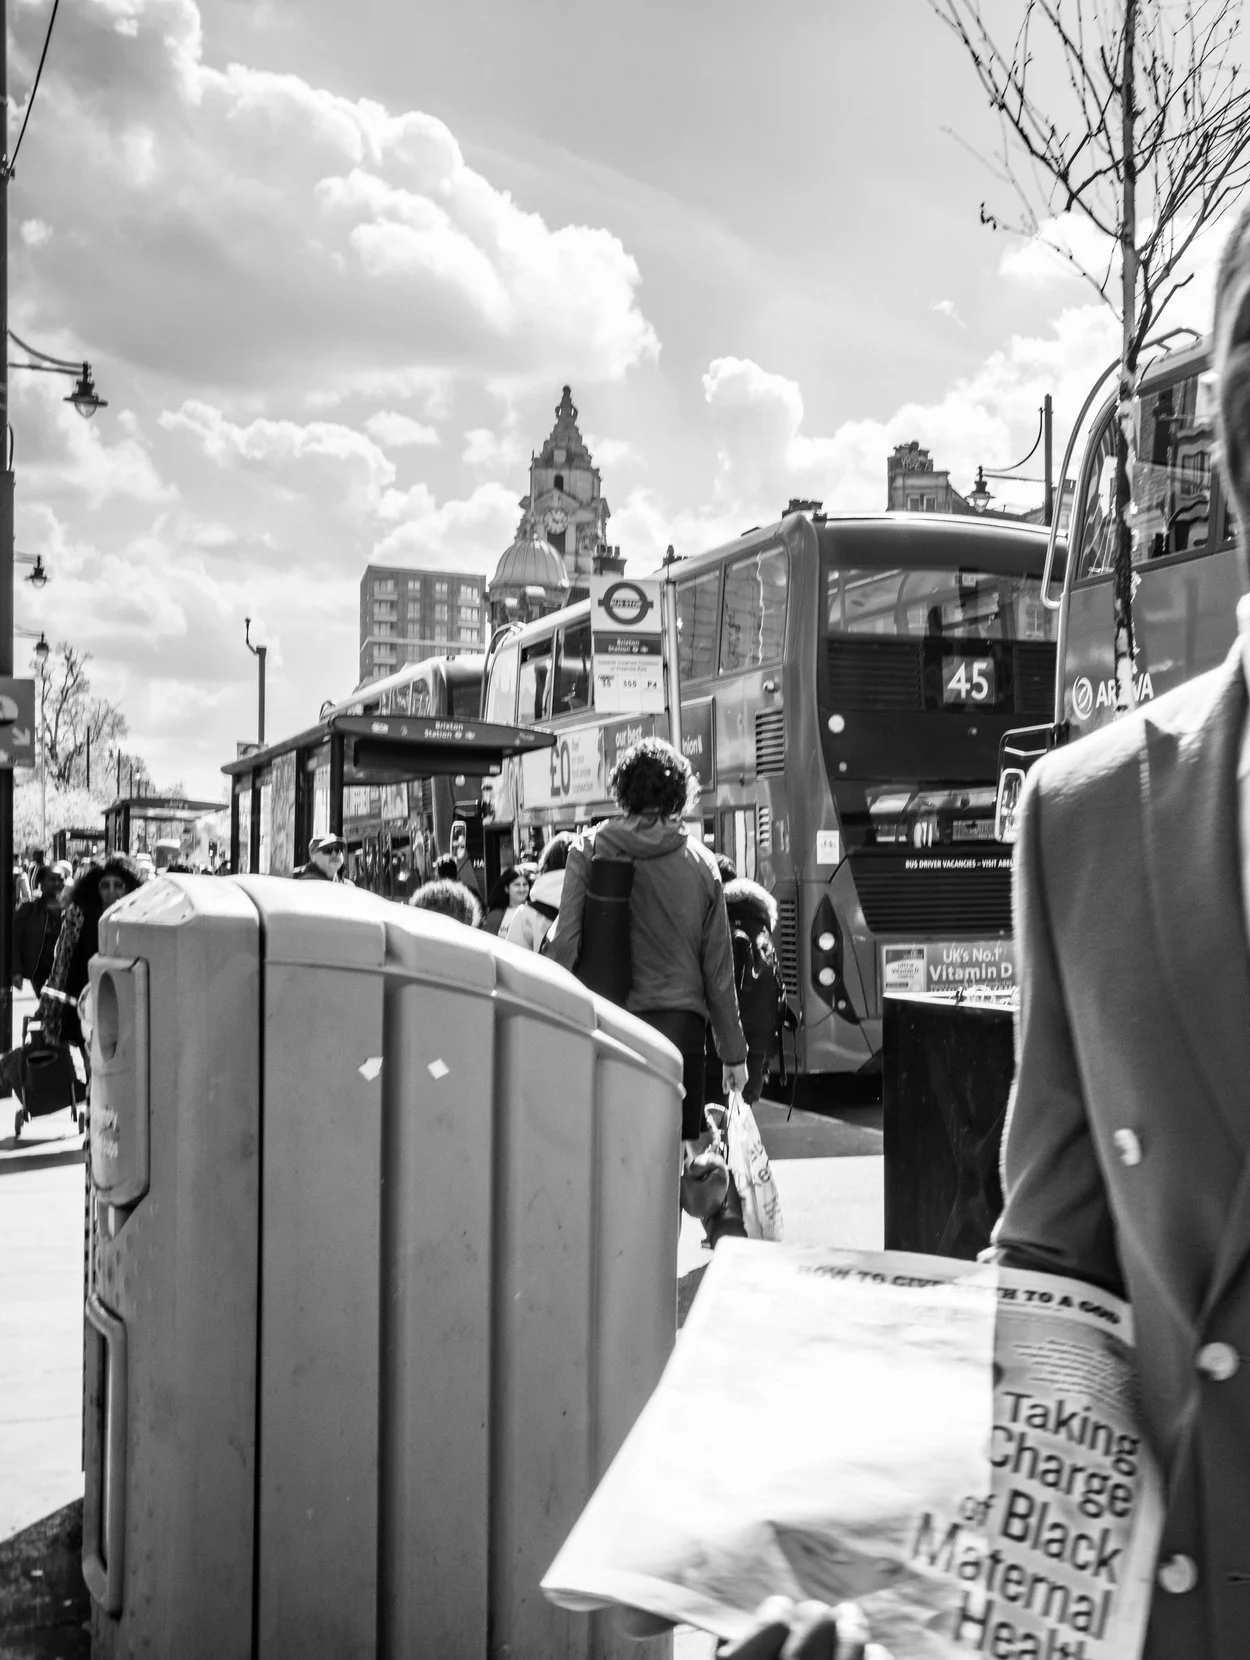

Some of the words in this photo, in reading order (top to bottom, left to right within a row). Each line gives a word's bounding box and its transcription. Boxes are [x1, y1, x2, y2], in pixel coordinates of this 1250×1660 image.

[946, 660, 989, 700] 45
[1095, 672, 1155, 708] ARVA
[424, 729, 452, 739] Station
[435, 721, 464, 731] Brixton
[905, 859, 918, 869] BUS
[919, 859, 941, 869] DRIVER
[942, 859, 976, 869] VACANCIES
[982, 859, 997, 868] VISIT
[943, 947, 969, 963] UK's
[929, 963, 997, 981] Vitamin
[1001, 962, 1013, 978] D
[1024, 1290, 1053, 1304] TO
[1058, 1295, 1074, 1308] A
[1002, 1390, 1141, 1477] Taking
[985, 1424, 1133, 1519] Charge
[1001, 1487, 1122, 1585] Black
[912, 1511, 1113, 1641] Maternal
